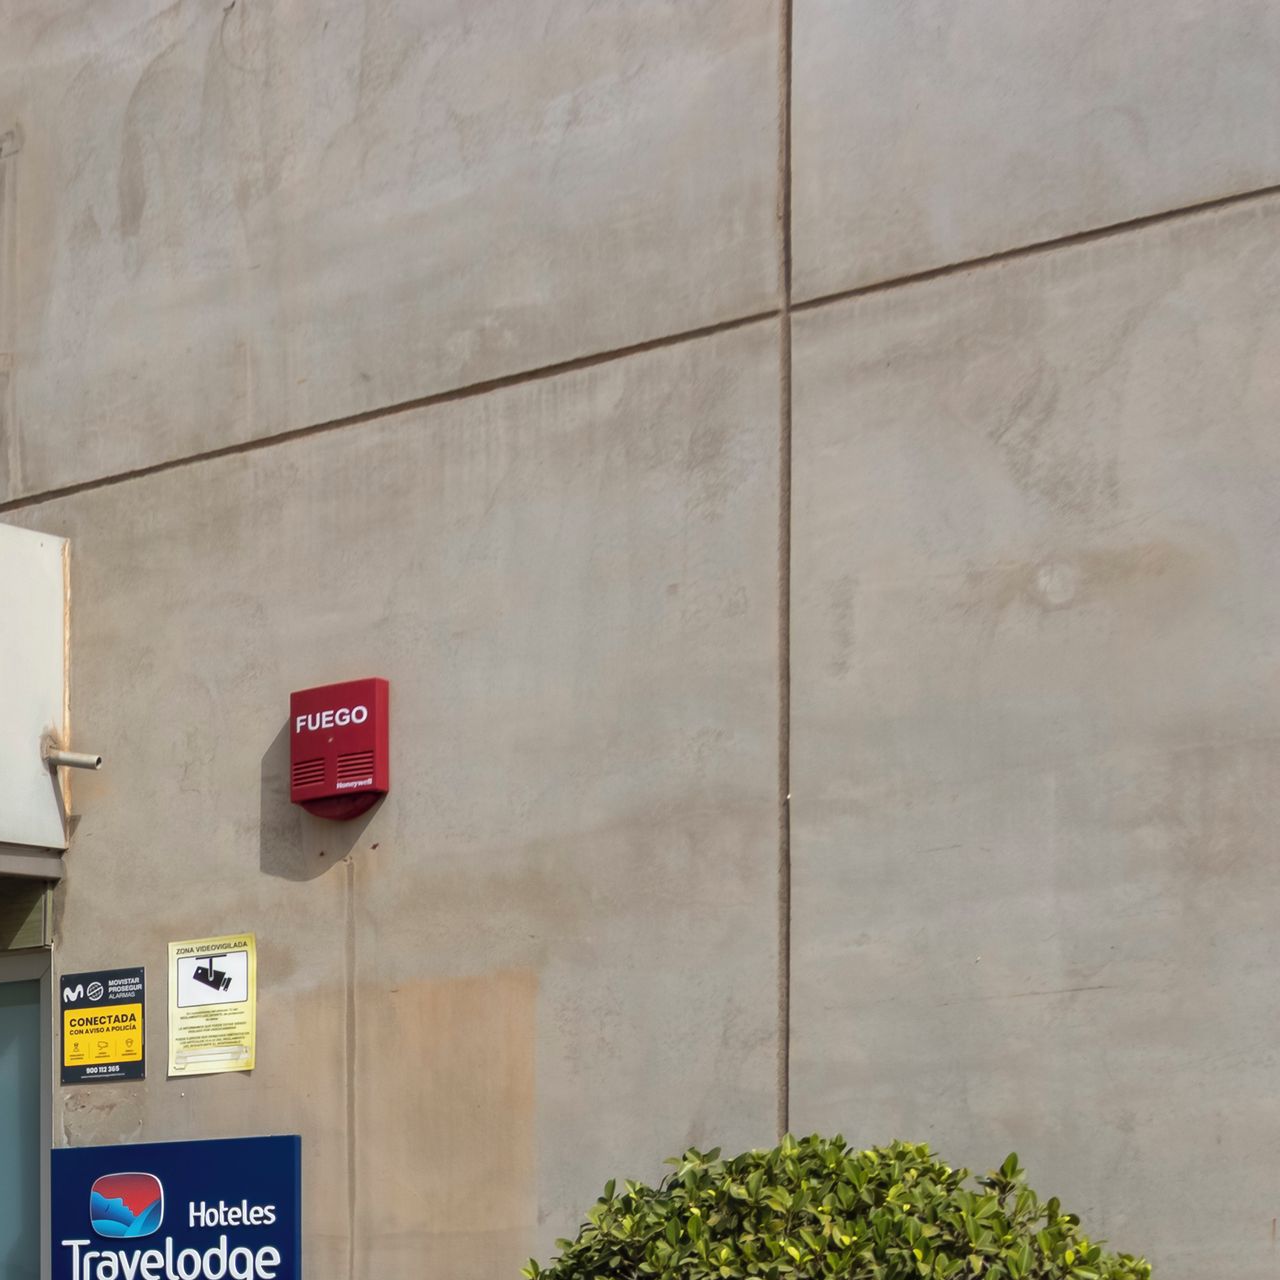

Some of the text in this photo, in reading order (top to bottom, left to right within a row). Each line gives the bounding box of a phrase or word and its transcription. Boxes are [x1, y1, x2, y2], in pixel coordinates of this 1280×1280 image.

[296, 705, 368, 734] FUEGO
[336, 778, 373, 789] Honeywell
[176, 941, 248, 955] ZONA VIDEOVIGILADA
[108, 977, 140, 986] MOVISTAR
[108, 984, 142, 993] PROSEGUR
[109, 991, 136, 999] ALARMAS
[69, 1013, 137, 1027] CONECTADA
[85, 1027, 105, 1035] AVISO
[111, 1024, 137, 1032] POLICÍA
[189, 1199, 276, 1228] Hoteles
